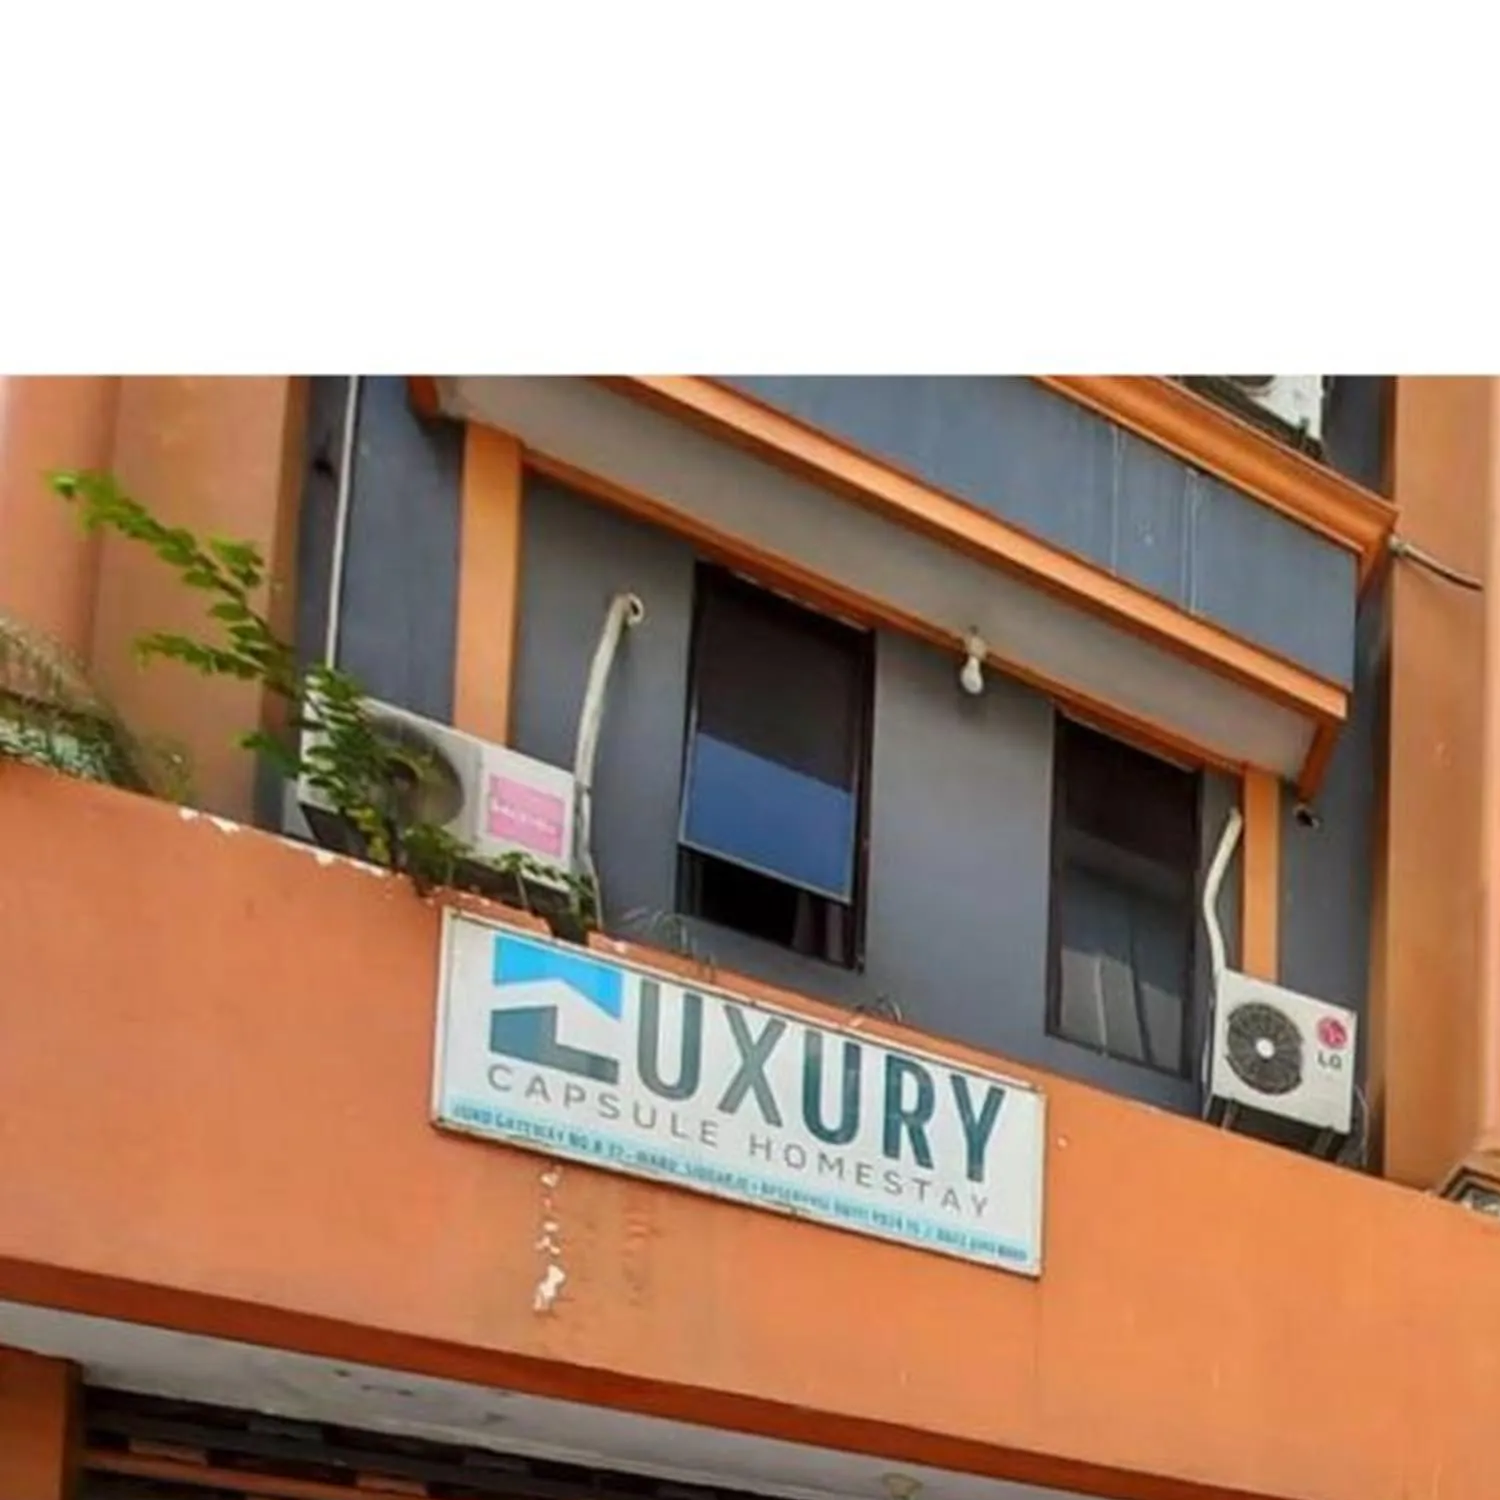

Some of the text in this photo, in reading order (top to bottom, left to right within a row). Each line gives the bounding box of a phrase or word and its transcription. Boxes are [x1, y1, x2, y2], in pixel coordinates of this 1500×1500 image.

[1317, 1052, 1342, 1070] LG
[487, 1065, 989, 1219] CAPSULE HOMESTAY
